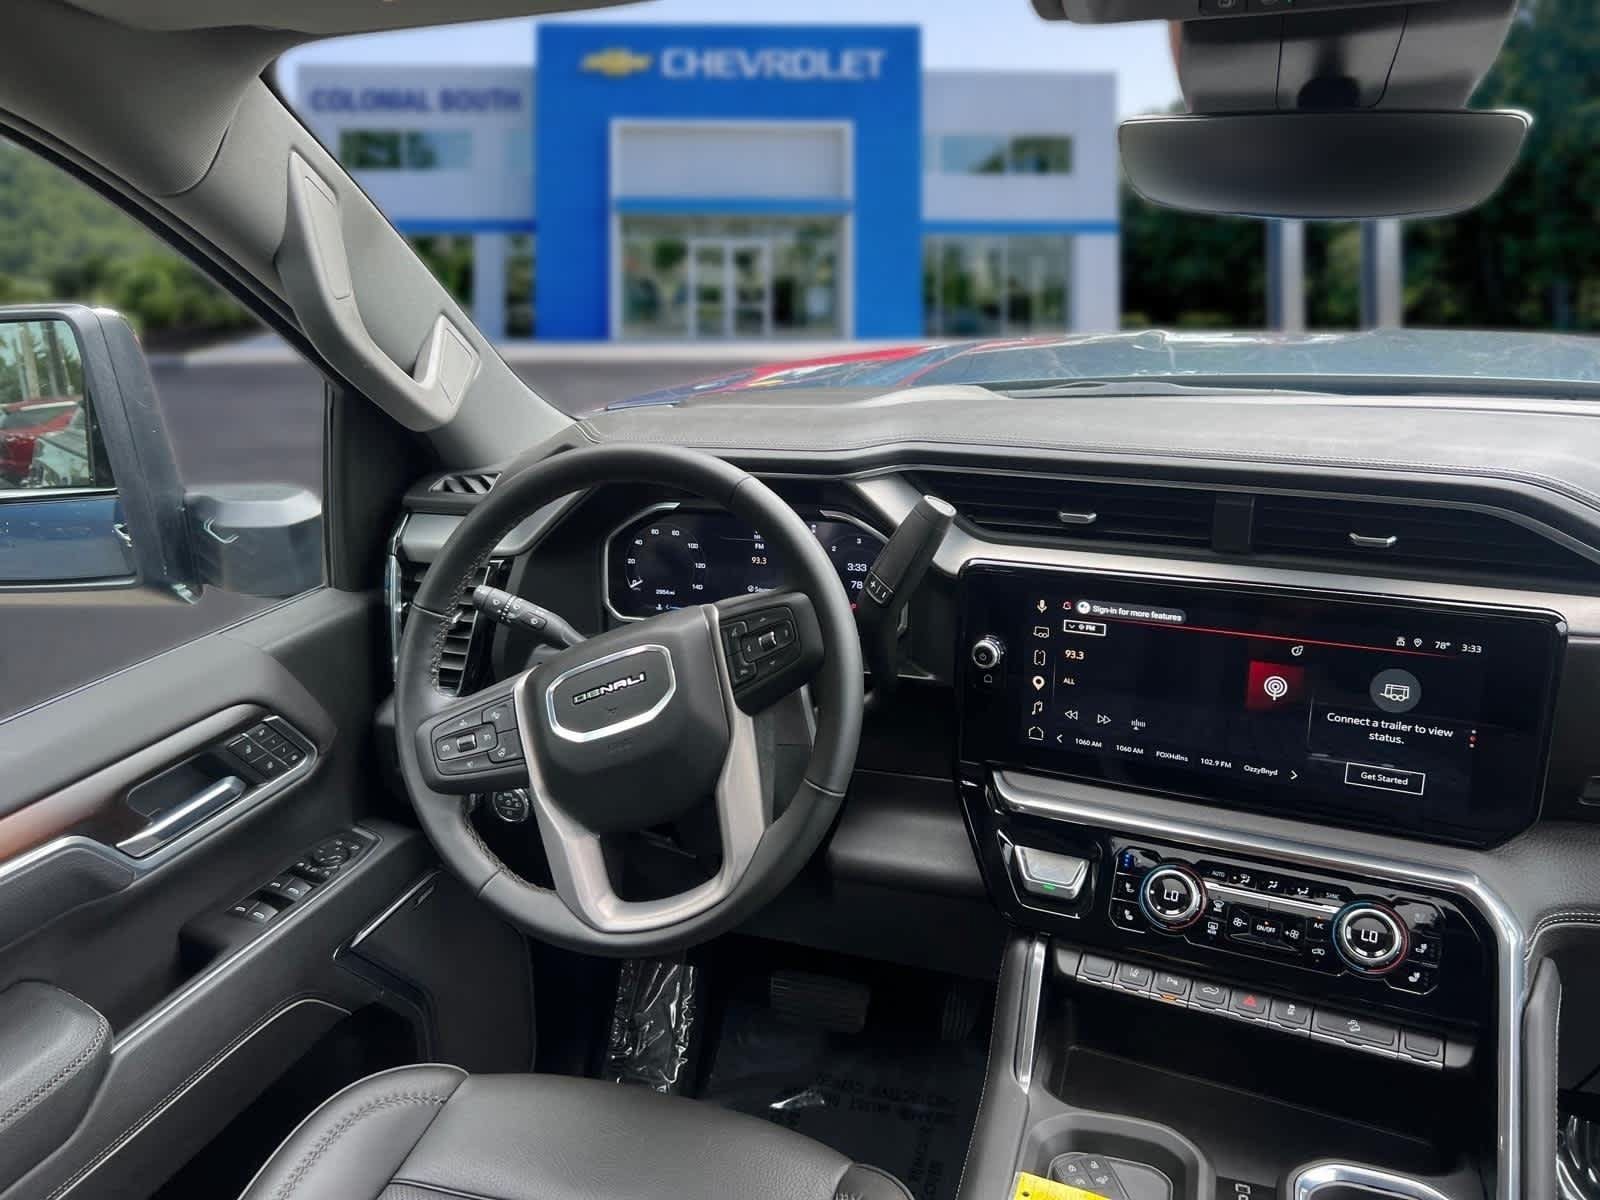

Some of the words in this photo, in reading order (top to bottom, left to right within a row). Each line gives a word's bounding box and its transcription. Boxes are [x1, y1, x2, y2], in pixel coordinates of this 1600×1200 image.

[661, 48, 886, 80] CHEVROLET
[307, 88, 430, 112] COLONIAL
[439, 87, 523, 113] SOUTH
[751, 556, 768, 565] 93.3
[847, 562, 867, 572] 3:33
[1092, 604, 1117, 615] Sign-in
[1118, 608, 1129, 616] for
[1130, 610, 1150, 618] more
[1151, 611, 1182, 622] features
[1064, 649, 1084, 660] 93.3
[1461, 643, 1482, 654] 3:33
[1063, 677, 1075, 686] ALL
[572, 672, 646, 705] DENALI
[1326, 712, 1370, 727] Connect
[1371, 719, 1379, 728] a
[1381, 720, 1412, 732] trailer
[1414, 724, 1426, 734] to
[1427, 726, 1453, 738] view
[1075, 738, 1091, 746] 1060
[1368, 732, 1405, 745] status.
[1116, 745, 1132, 753] 1060
[1132, 747, 1144, 755] AM
[1200, 757, 1219, 767] 102.9
[1220, 761, 1232, 769] FM
[1360, 771, 1377, 781] Get
[1377, 773, 1408, 786] Started
